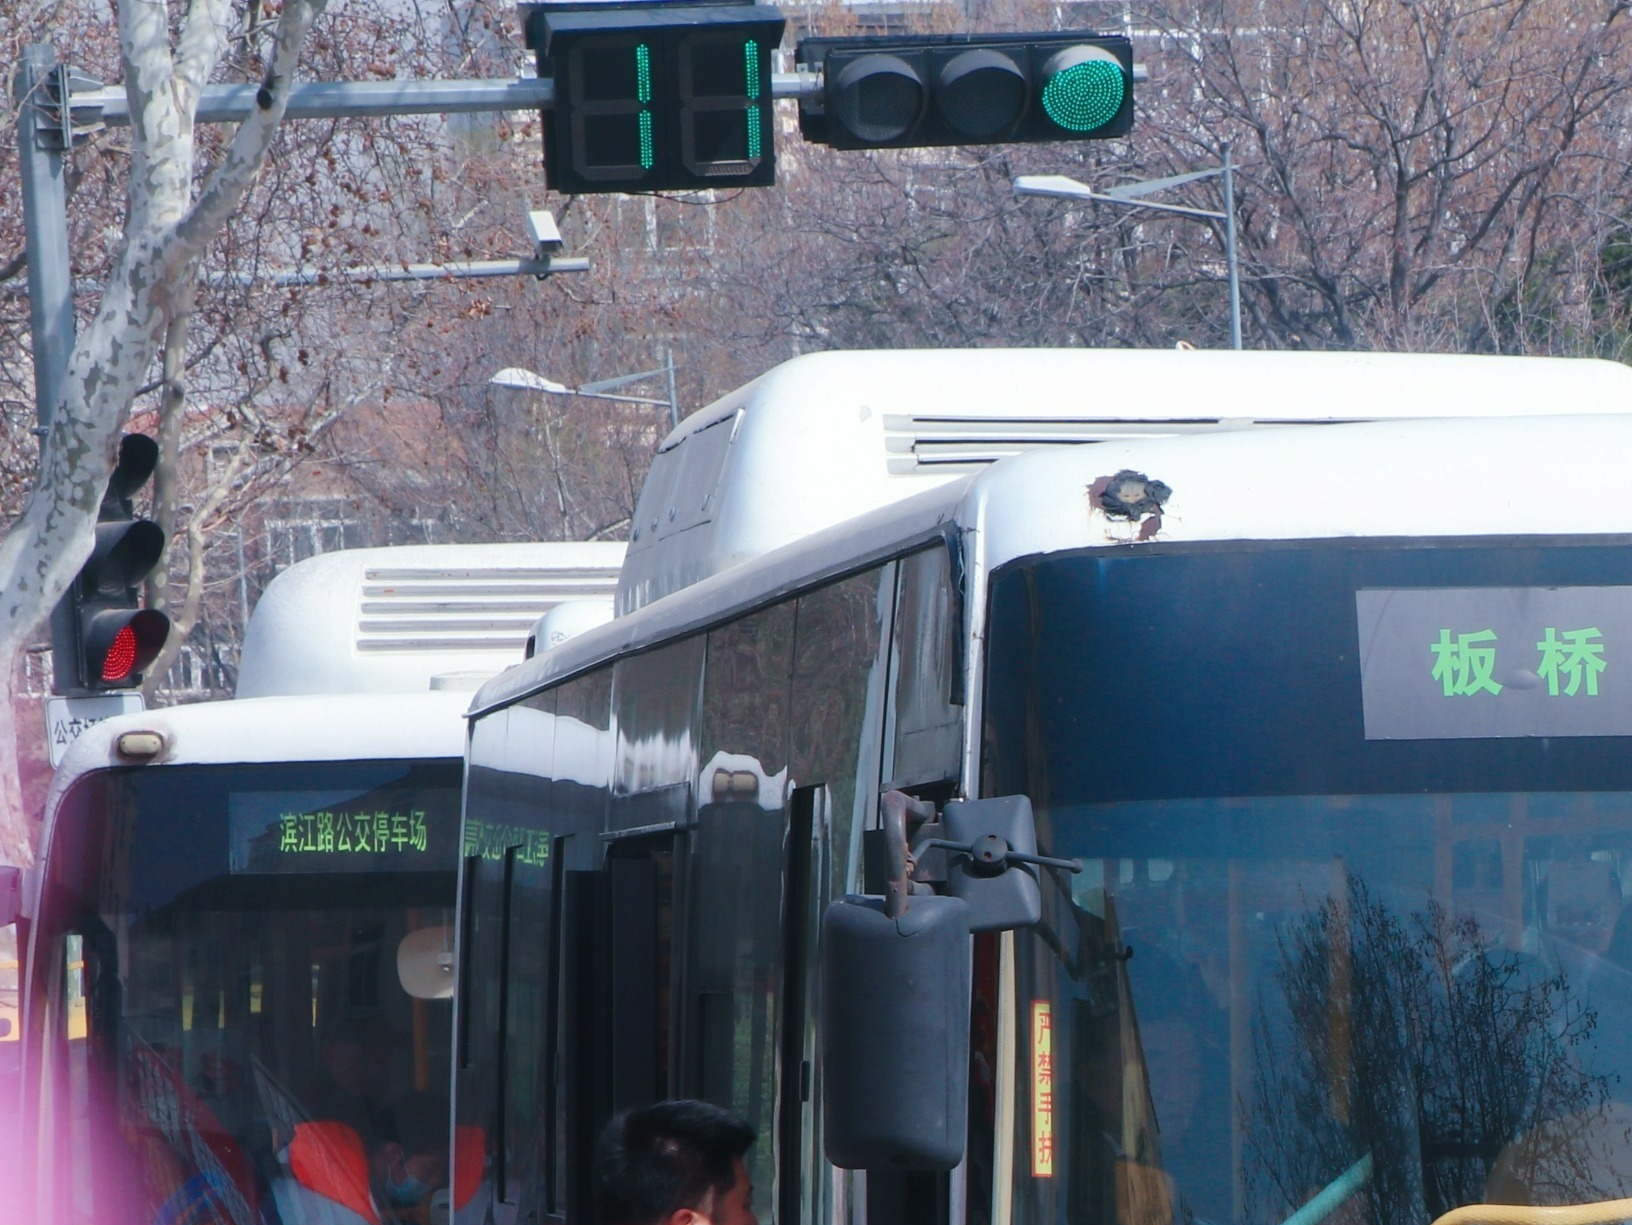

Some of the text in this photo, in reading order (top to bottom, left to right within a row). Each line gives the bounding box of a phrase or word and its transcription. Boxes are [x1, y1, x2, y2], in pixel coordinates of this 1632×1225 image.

[279, 810, 428, 854] 滨江路公交停车场
